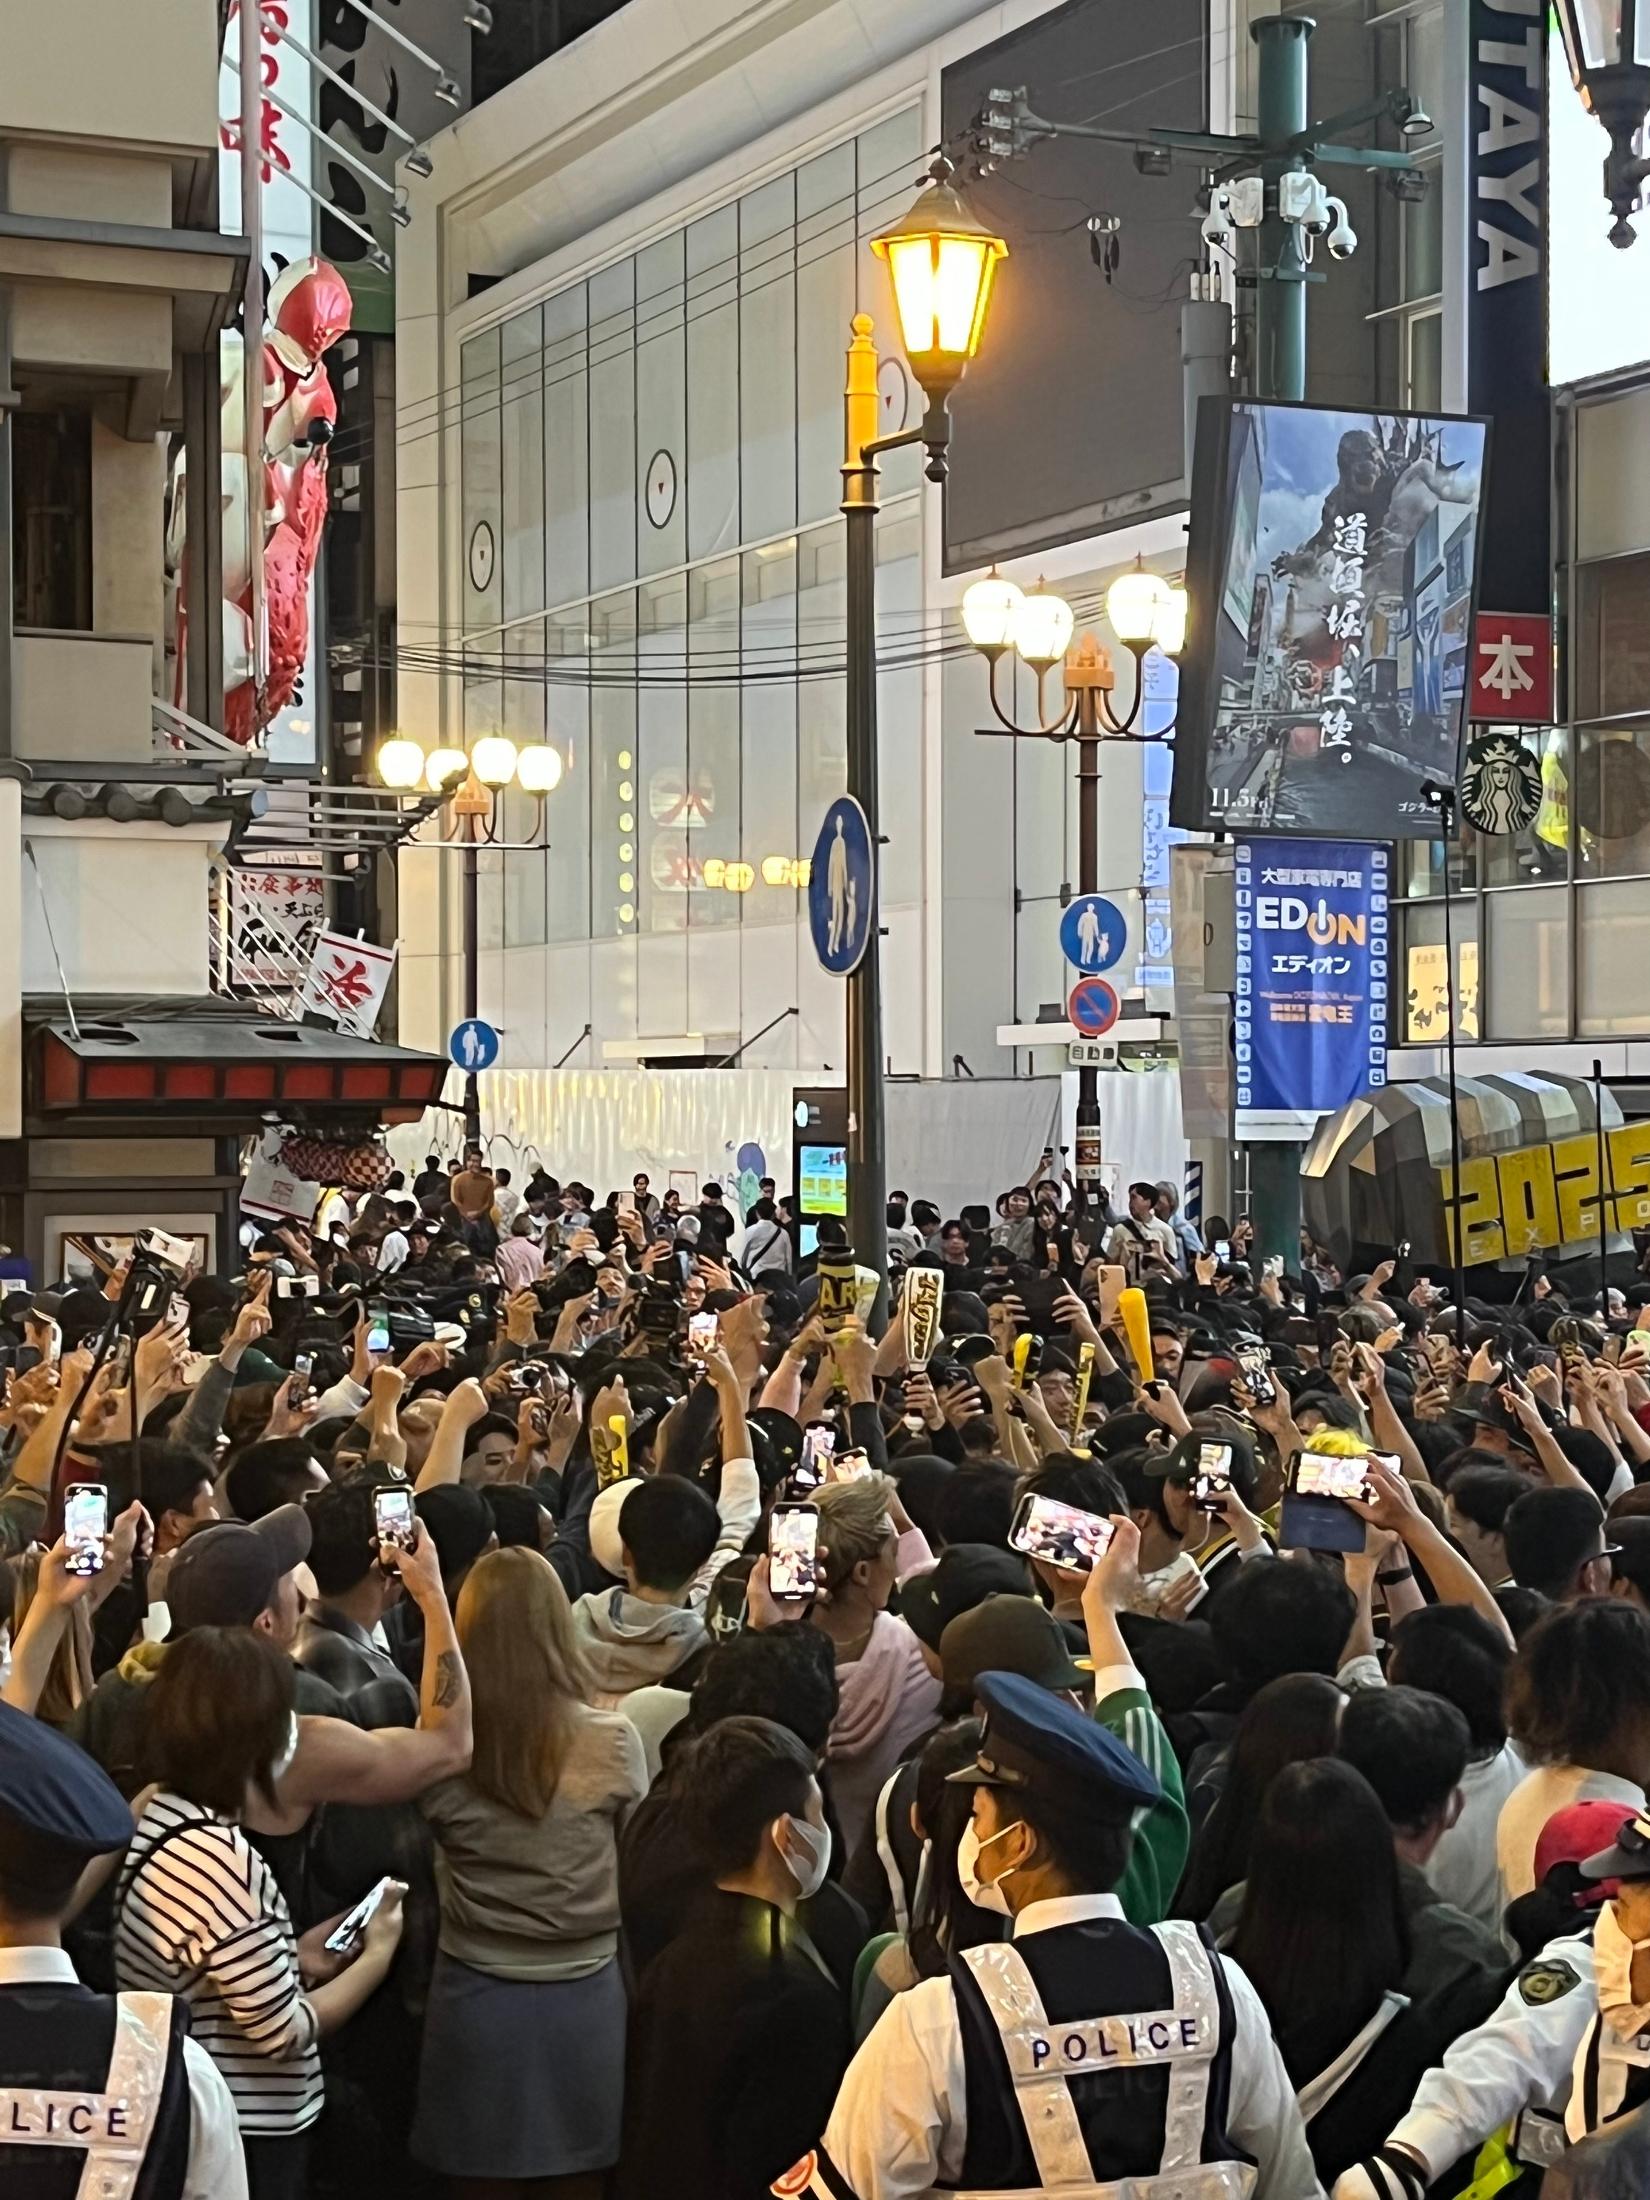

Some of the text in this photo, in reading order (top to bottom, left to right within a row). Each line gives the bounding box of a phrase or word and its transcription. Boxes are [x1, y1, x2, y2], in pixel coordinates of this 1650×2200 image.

[1477, 0, 1542, 291] TAYA
[1478, 634, 1534, 700] 本
[1256, 896, 1367, 946] EDION
[1271, 955, 1351, 975] エディオン
[1441, 1121, 1650, 1268] 2025
[1033, 2018, 1201, 2068] POLICE
[11, 2101, 127, 2137] LICE
